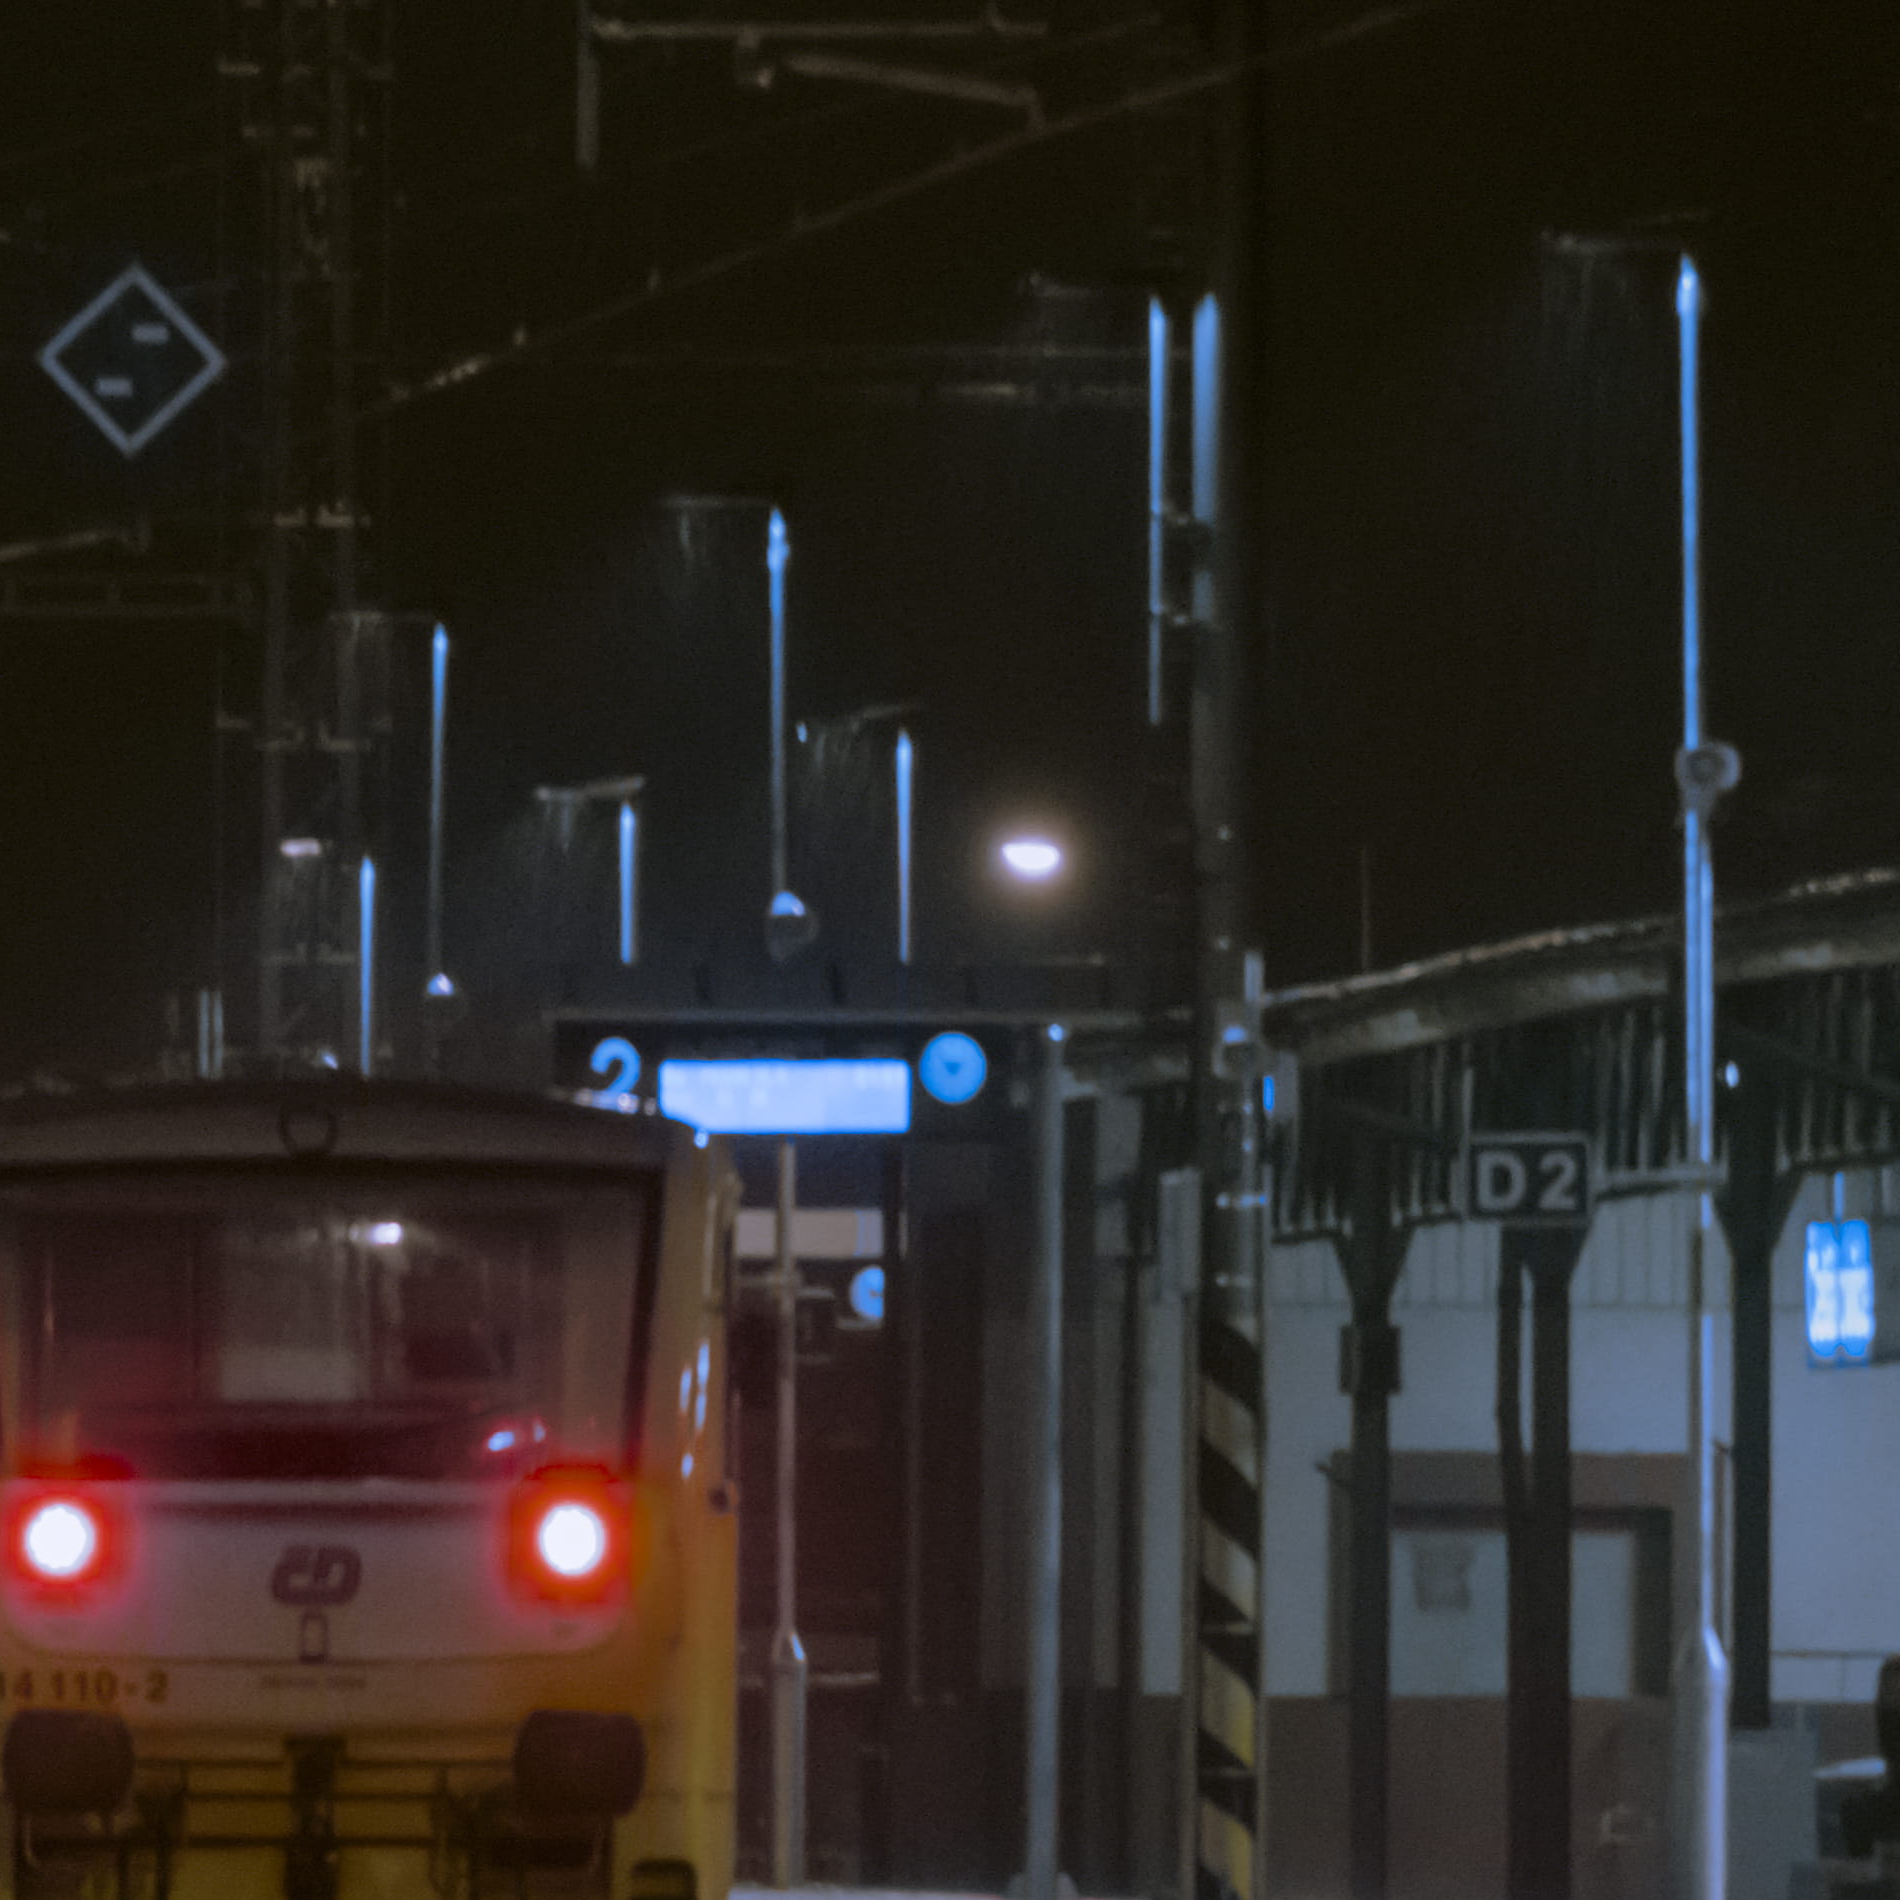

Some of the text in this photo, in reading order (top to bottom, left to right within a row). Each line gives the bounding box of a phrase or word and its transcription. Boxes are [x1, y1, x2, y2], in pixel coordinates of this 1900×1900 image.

[590, 1037, 641, 1112] 2
[1477, 1150, 1576, 1211] D2
[47, 1668, 170, 1704] 110-2
